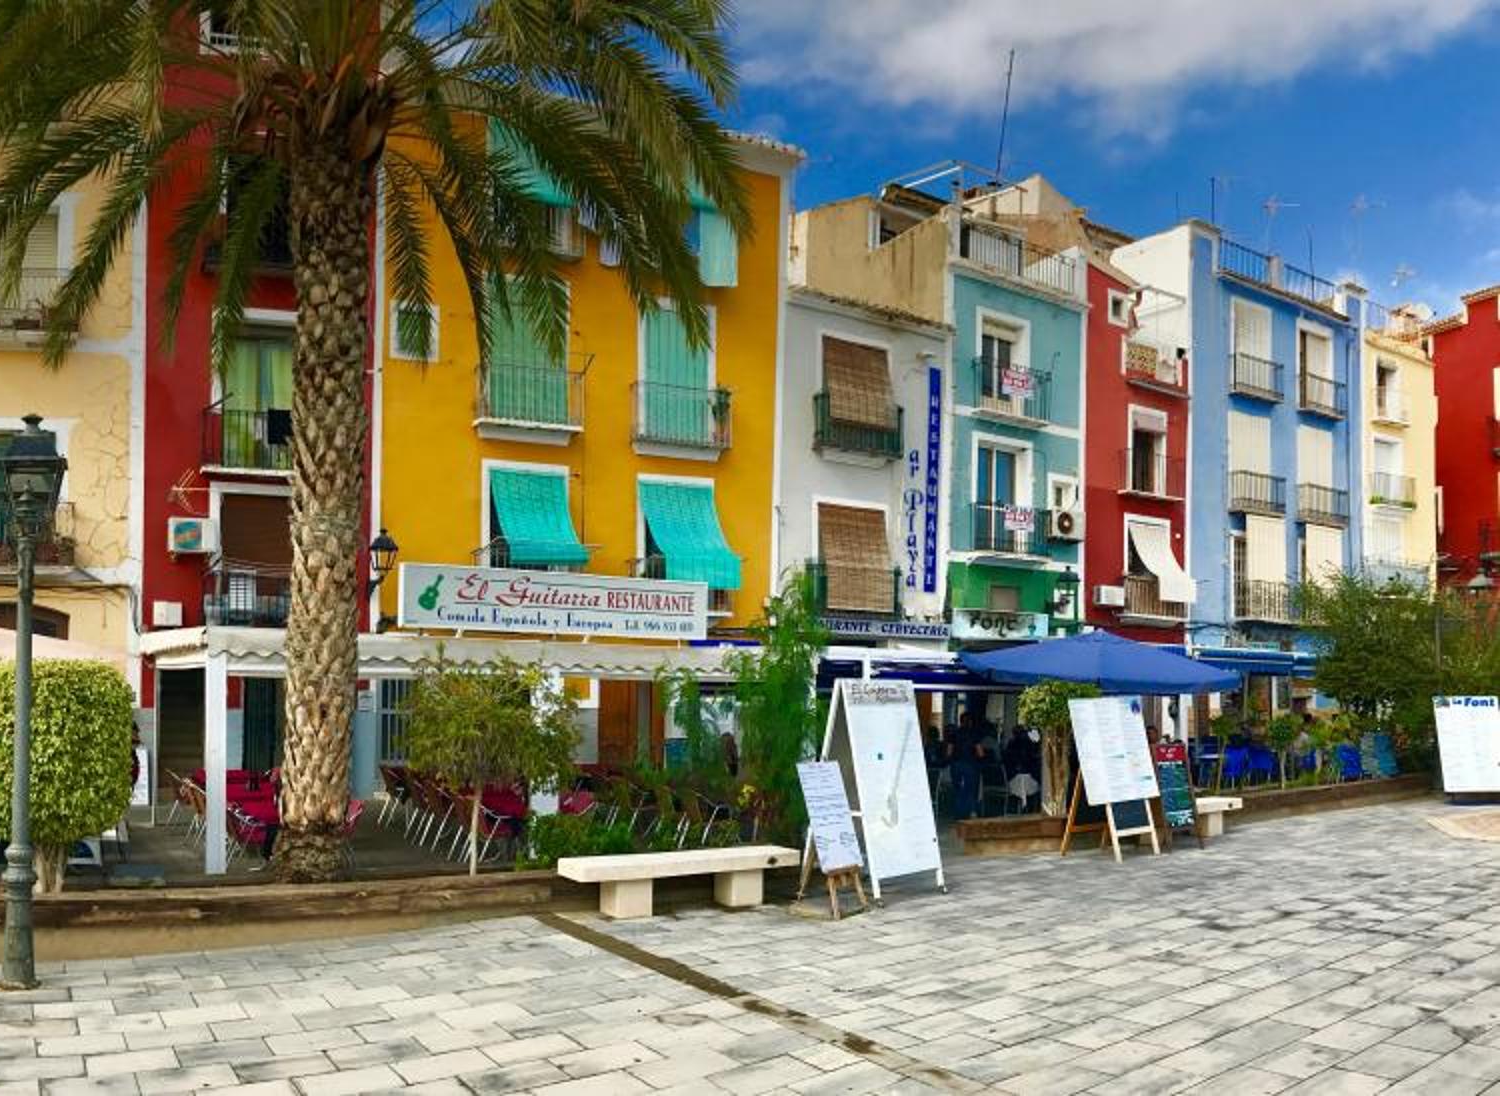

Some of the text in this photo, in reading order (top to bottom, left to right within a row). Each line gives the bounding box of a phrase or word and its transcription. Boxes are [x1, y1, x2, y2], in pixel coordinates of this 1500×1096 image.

[457, 573, 695, 613] El Guitarra RESTAURANTE
[437, 605, 485, 623] Comida
[1464, 697, 1495, 707] Font
